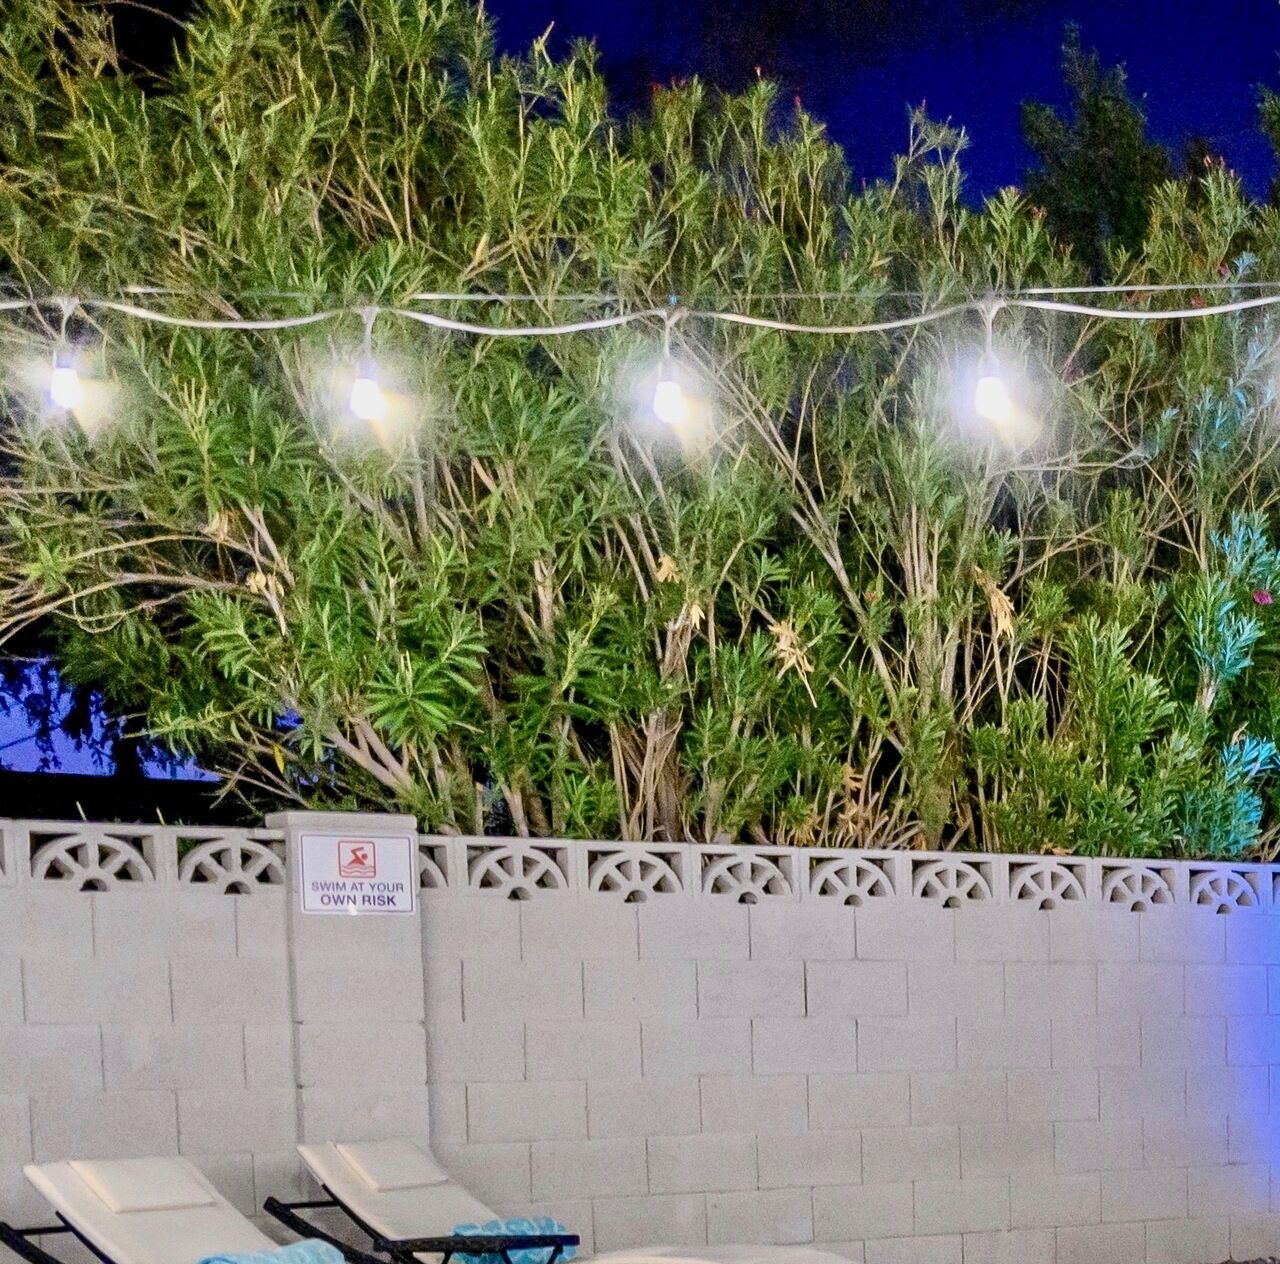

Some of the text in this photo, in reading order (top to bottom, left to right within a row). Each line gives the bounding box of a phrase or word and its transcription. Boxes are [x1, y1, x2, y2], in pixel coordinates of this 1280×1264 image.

[311, 881, 404, 893] SWIM AT YOUR
[320, 894, 397, 906] OWN RISK
